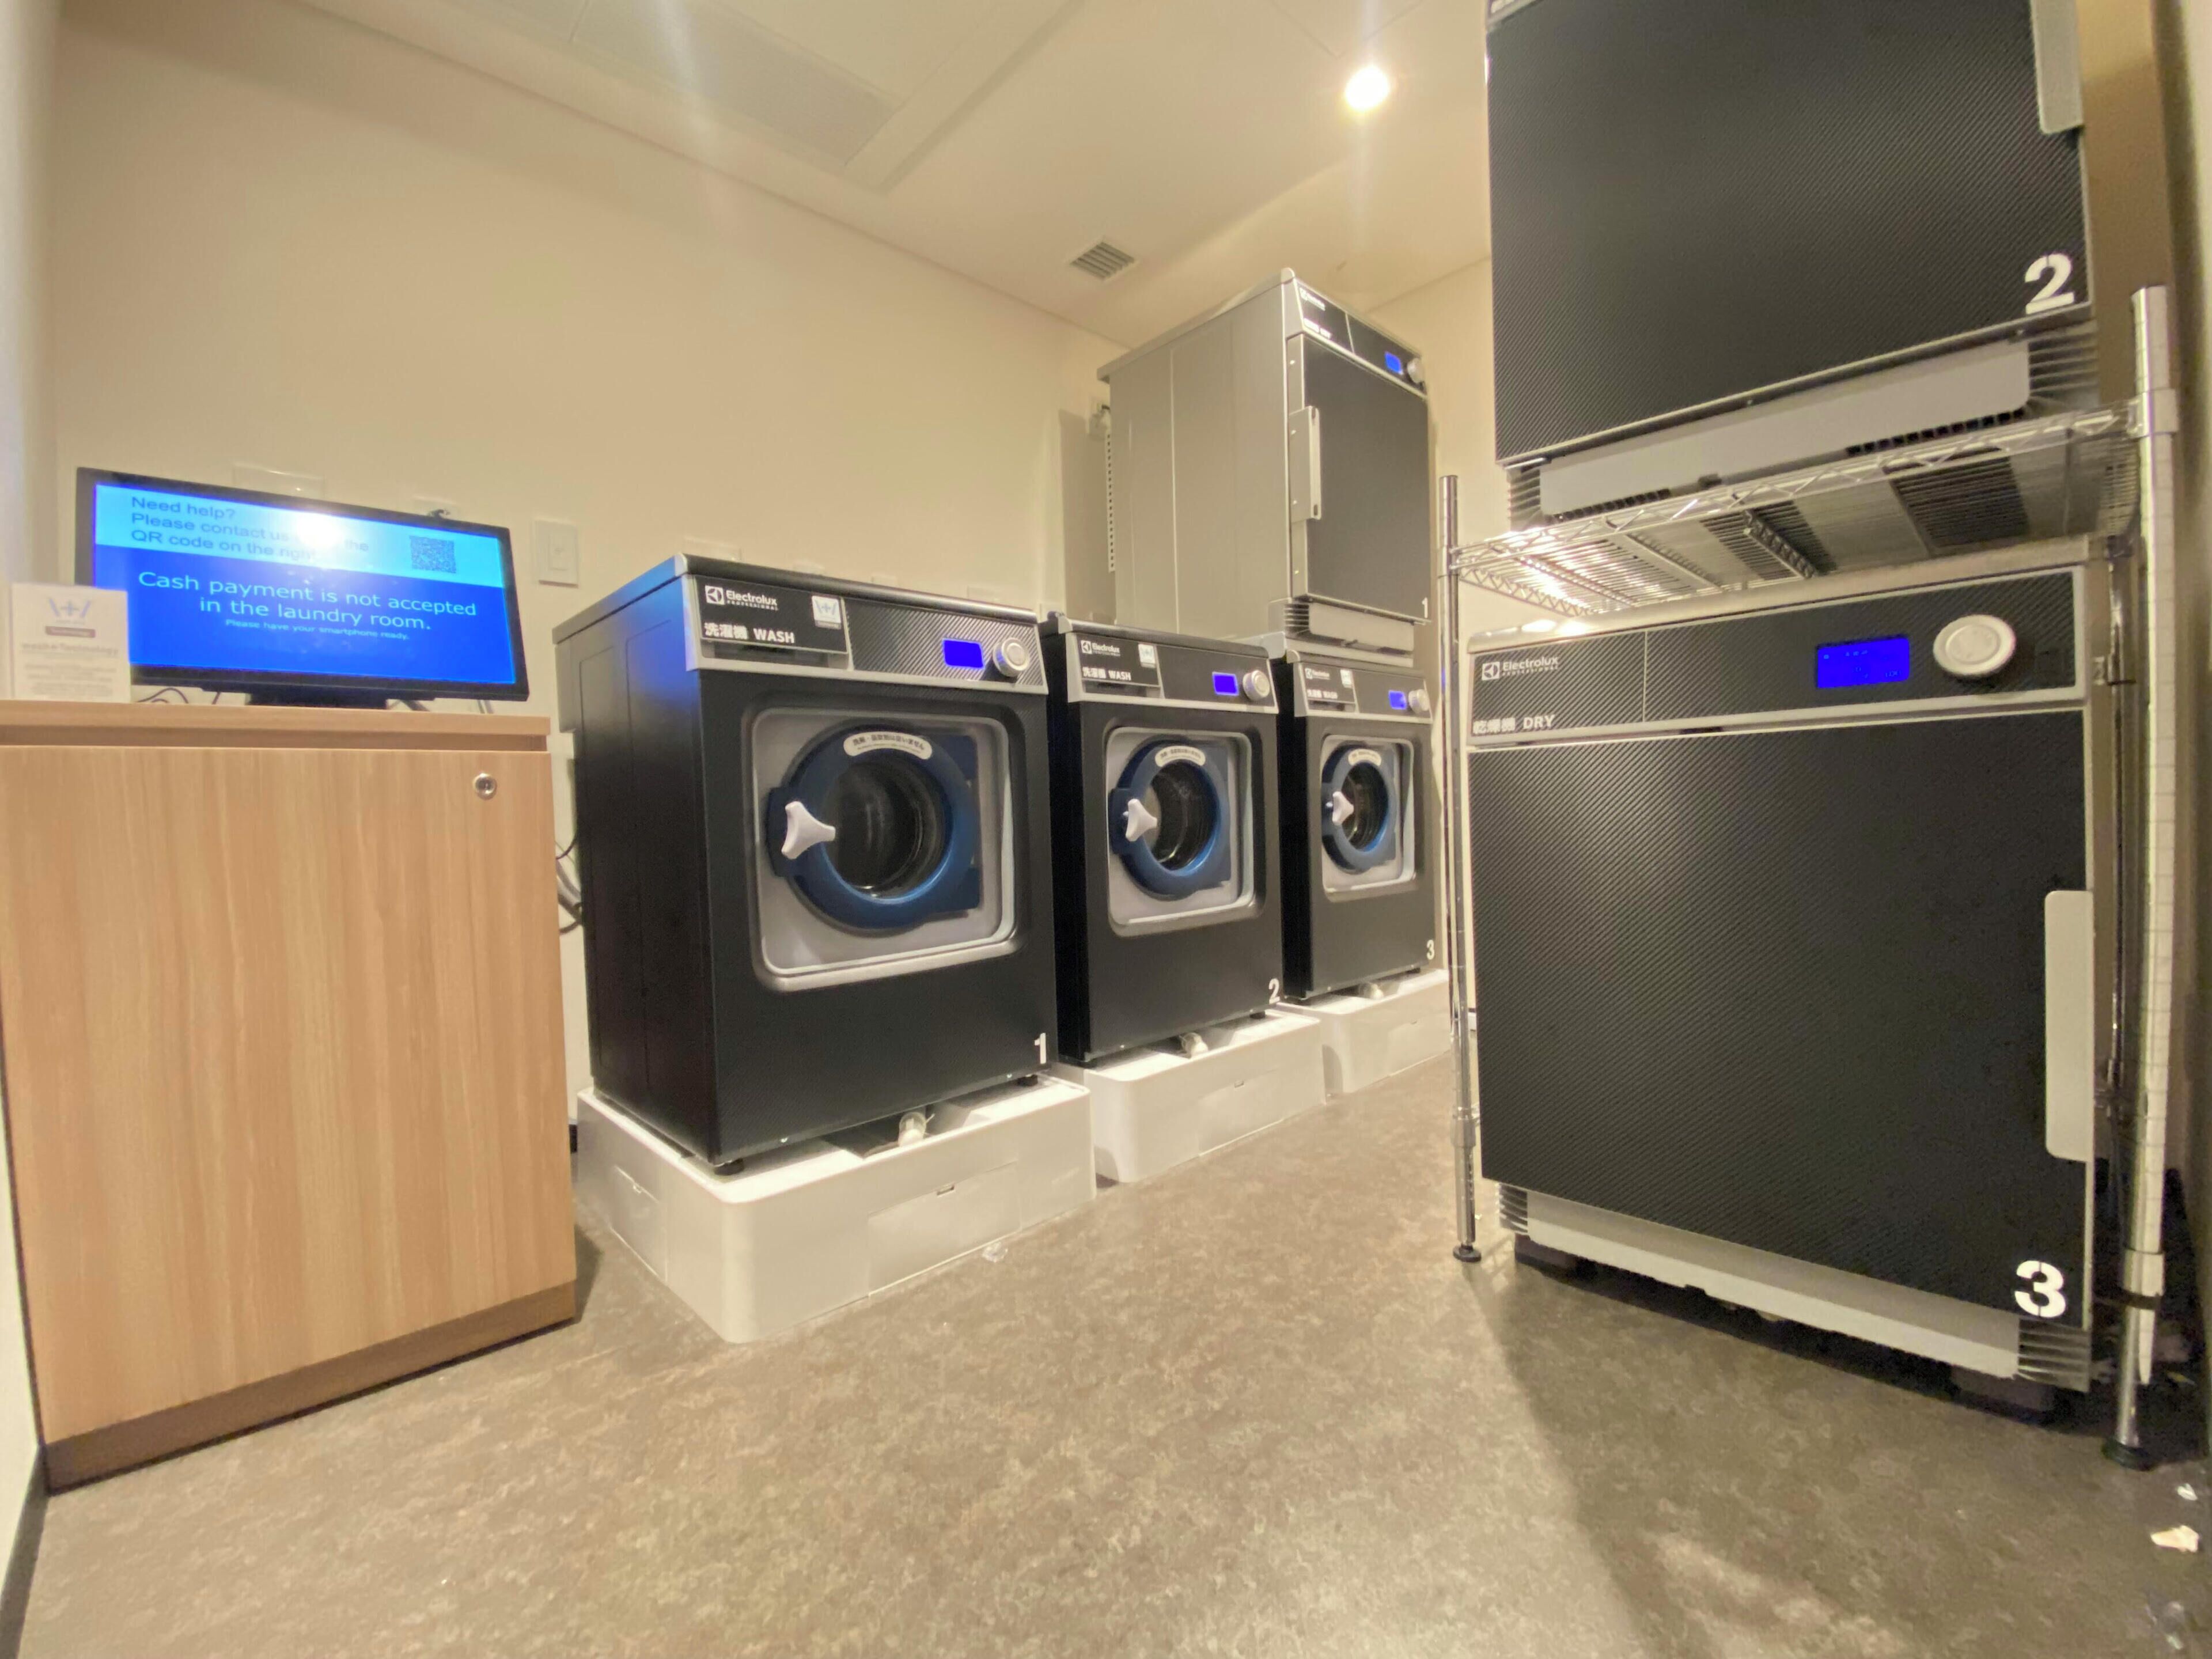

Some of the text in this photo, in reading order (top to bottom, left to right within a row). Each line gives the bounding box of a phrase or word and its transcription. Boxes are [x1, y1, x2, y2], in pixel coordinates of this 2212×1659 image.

[2025, 253, 2074, 315] 2
[132, 497, 235, 520] Need help?
[132, 513, 195, 530] Please
[201, 523, 266, 539] contact
[131, 529, 162, 543] QR
[169, 536, 213, 549] code
[219, 541, 241, 552] on
[248, 543, 274, 555] the
[138, 571, 477, 616] Cash payment is not accepted
[726, 590, 778, 605] Electrolux
[200, 596, 431, 630] in the laundry room.
[1422, 597, 1428, 618] 1
[226, 619, 410, 641] Please have your smartphone ready.
[753, 627, 795, 643] WASH
[1108, 669, 1132, 681] WASH
[1502, 656, 1559, 672] Electrolux
[1522, 714, 1556, 730] DRY
[1426, 940, 1435, 960] 3
[1268, 978, 1280, 1004] 2
[1034, 1032, 1047, 1065] 1
[2015, 1260, 2067, 1318] 3
